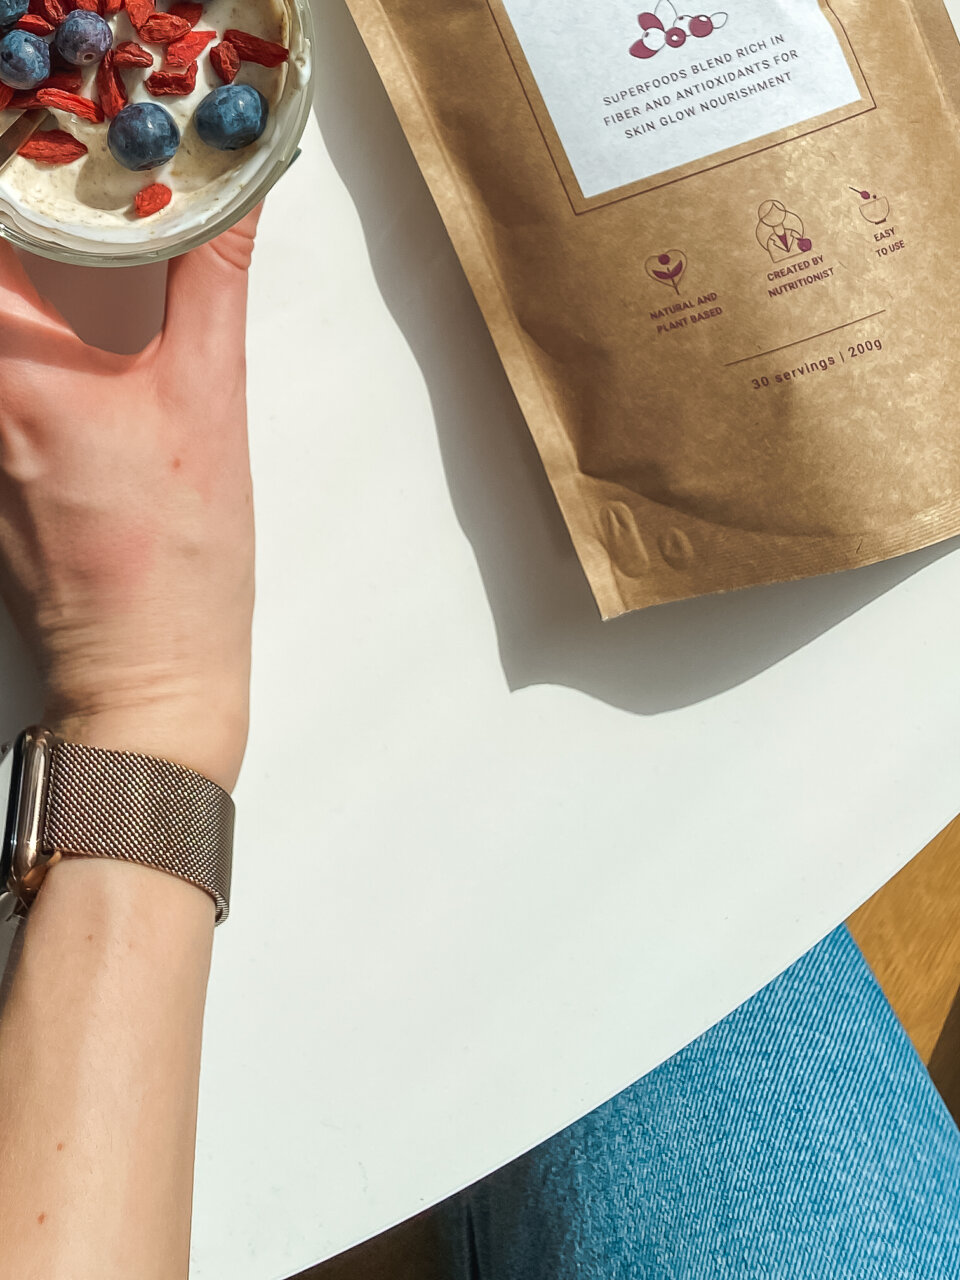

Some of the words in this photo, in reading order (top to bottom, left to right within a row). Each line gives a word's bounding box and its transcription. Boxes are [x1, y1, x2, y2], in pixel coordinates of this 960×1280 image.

[602, 68, 688, 107] SUPERFOODS
[690, 52, 733, 76] BLEND
[735, 40, 768, 59] RICH
[770, 33, 786, 46] IN
[603, 105, 642, 127] FIBER
[644, 95, 672, 115] AND
[675, 58, 771, 104] ANTIOXIDANTS
[773, 49, 799, 67] FOR
[624, 122, 657, 140] SKIN
[659, 106, 697, 129] GLOW
[699, 70, 793, 114] NOURISHMENT
[873, 227, 896, 243] EASY
[875, 246, 888, 258] TO
[889, 239, 906, 254] USE
[766, 261, 811, 282] CREATED
[811, 254, 825, 268] BY
[767, 267, 836, 298] NUTRITIONIST
[649, 299, 695, 321] NATURAL
[697, 292, 718, 308] AND
[656, 316, 689, 335] PLANT
[690, 306, 724, 324] BASED
[751, 375, 770, 390] 30
[774, 355, 836, 384] servings
[847, 337, 884, 359] 200g
